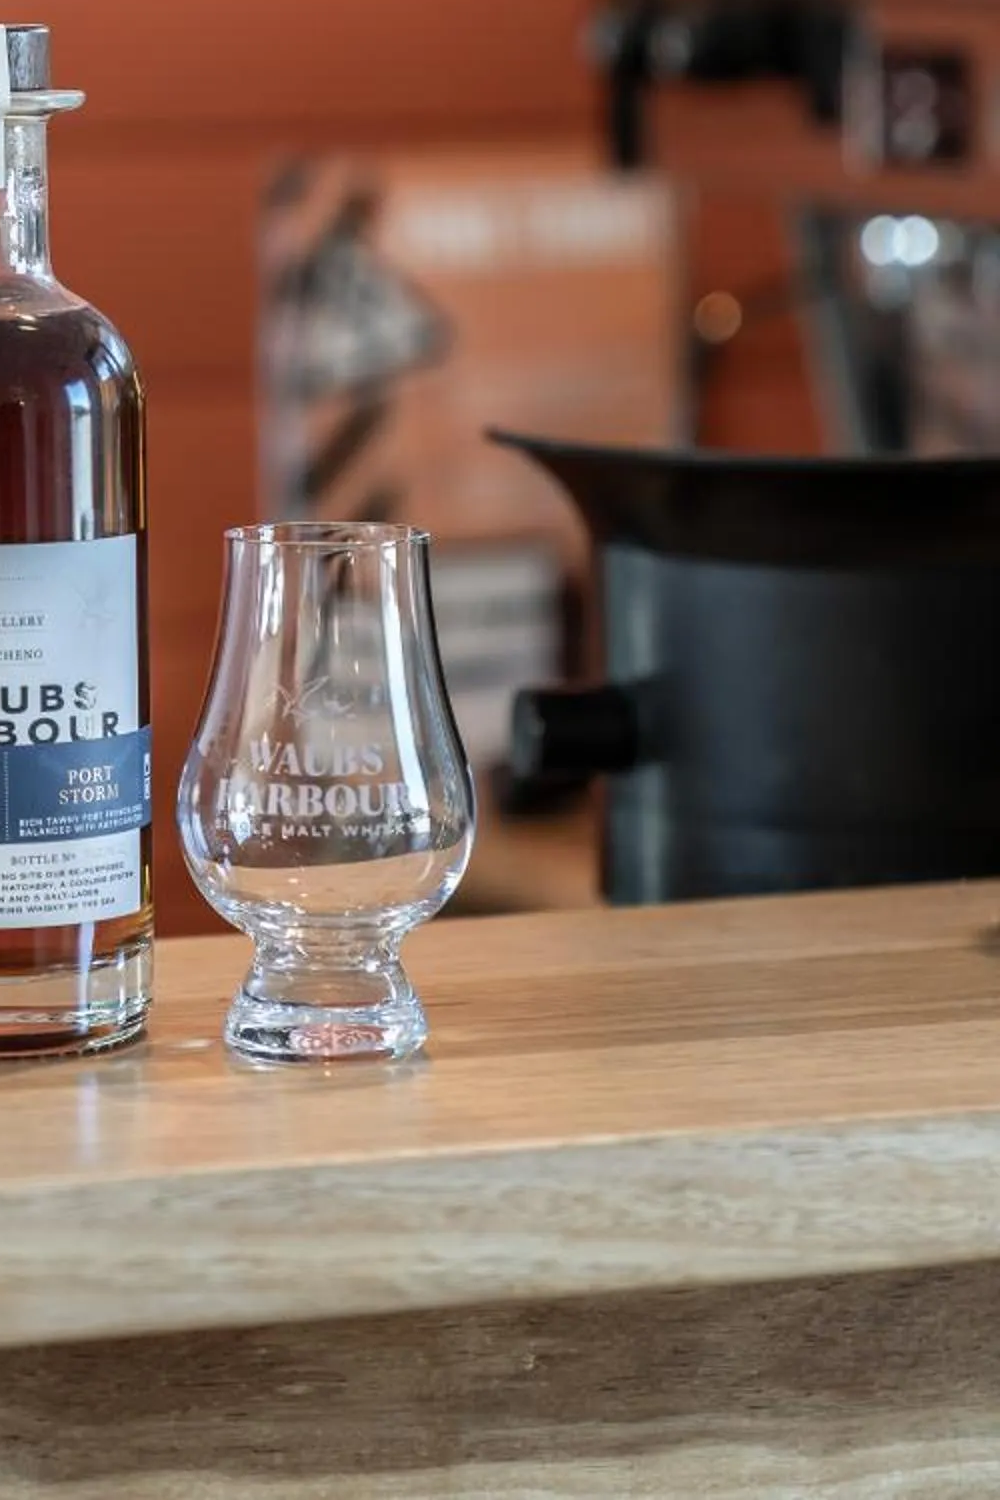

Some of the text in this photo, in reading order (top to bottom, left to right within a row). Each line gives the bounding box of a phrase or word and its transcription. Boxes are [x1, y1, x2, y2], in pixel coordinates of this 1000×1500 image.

[250, 739, 383, 777] WAUBS
[67, 765, 114, 785] PORT
[58, 783, 119, 805] STORM
[281, 824, 332, 837] MALT
[10, 853, 59, 866] BOTTLE
[9, 894, 30, 903] AND
